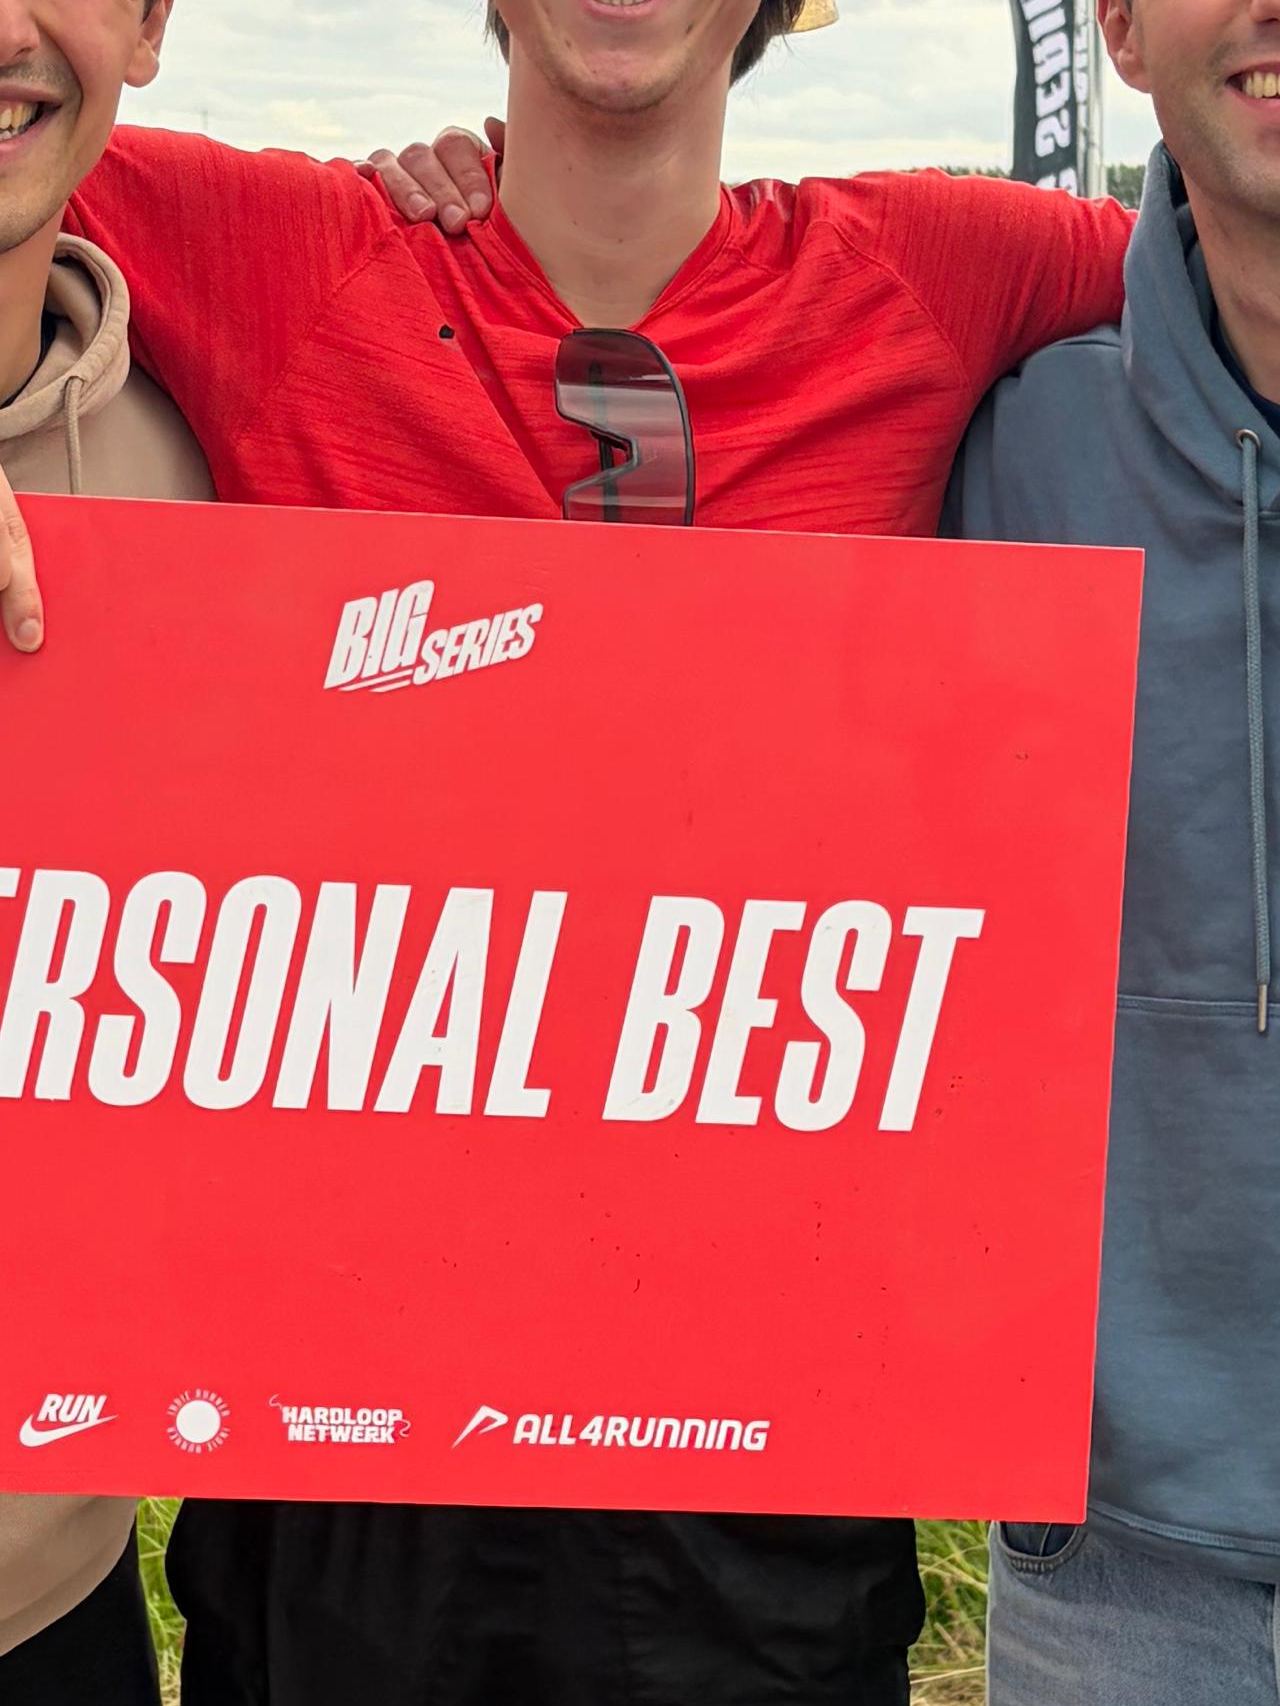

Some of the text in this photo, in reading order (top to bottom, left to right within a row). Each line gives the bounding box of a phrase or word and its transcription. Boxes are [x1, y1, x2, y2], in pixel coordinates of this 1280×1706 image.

[323, 580, 544, 690] BIG SERIES
[602, 895, 986, 1132] BEST
[38, 1393, 107, 1423] RUN
[281, 1406, 404, 1426] HARDLOOP
[287, 1424, 395, 1444] NETWERK
[513, 1413, 770, 1451] ALL4RUNNING
